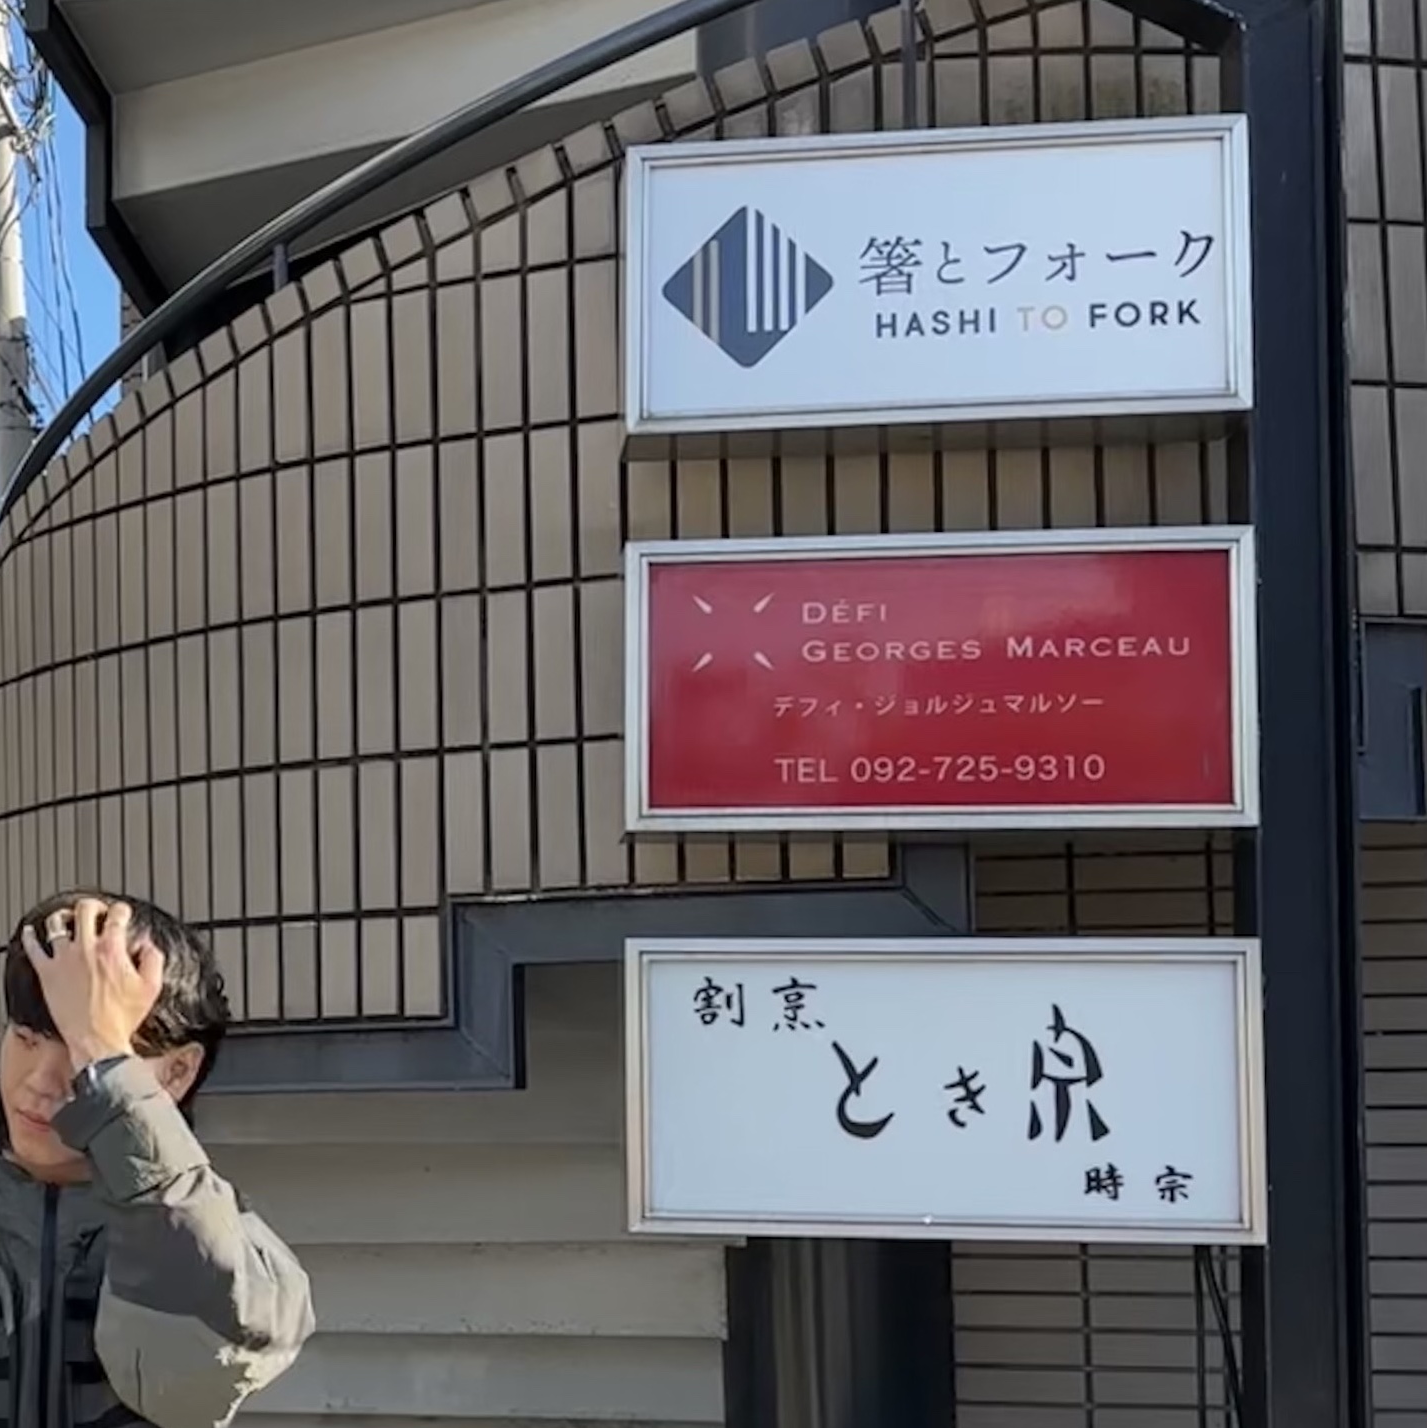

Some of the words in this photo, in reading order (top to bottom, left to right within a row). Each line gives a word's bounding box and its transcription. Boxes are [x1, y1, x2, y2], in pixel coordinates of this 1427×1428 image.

[860, 231, 1214, 297] 箸とフォーク
[876, 307, 996, 339] HASHI
[1016, 305, 1069, 332] TO
[1089, 299, 1201, 329] FORK
[773, 757, 838, 783] TEL
[850, 753, 1105, 783] 092-725-9310
[693, 976, 826, 1032] 割烹
[1083, 1164, 1194, 1204] 時宗
